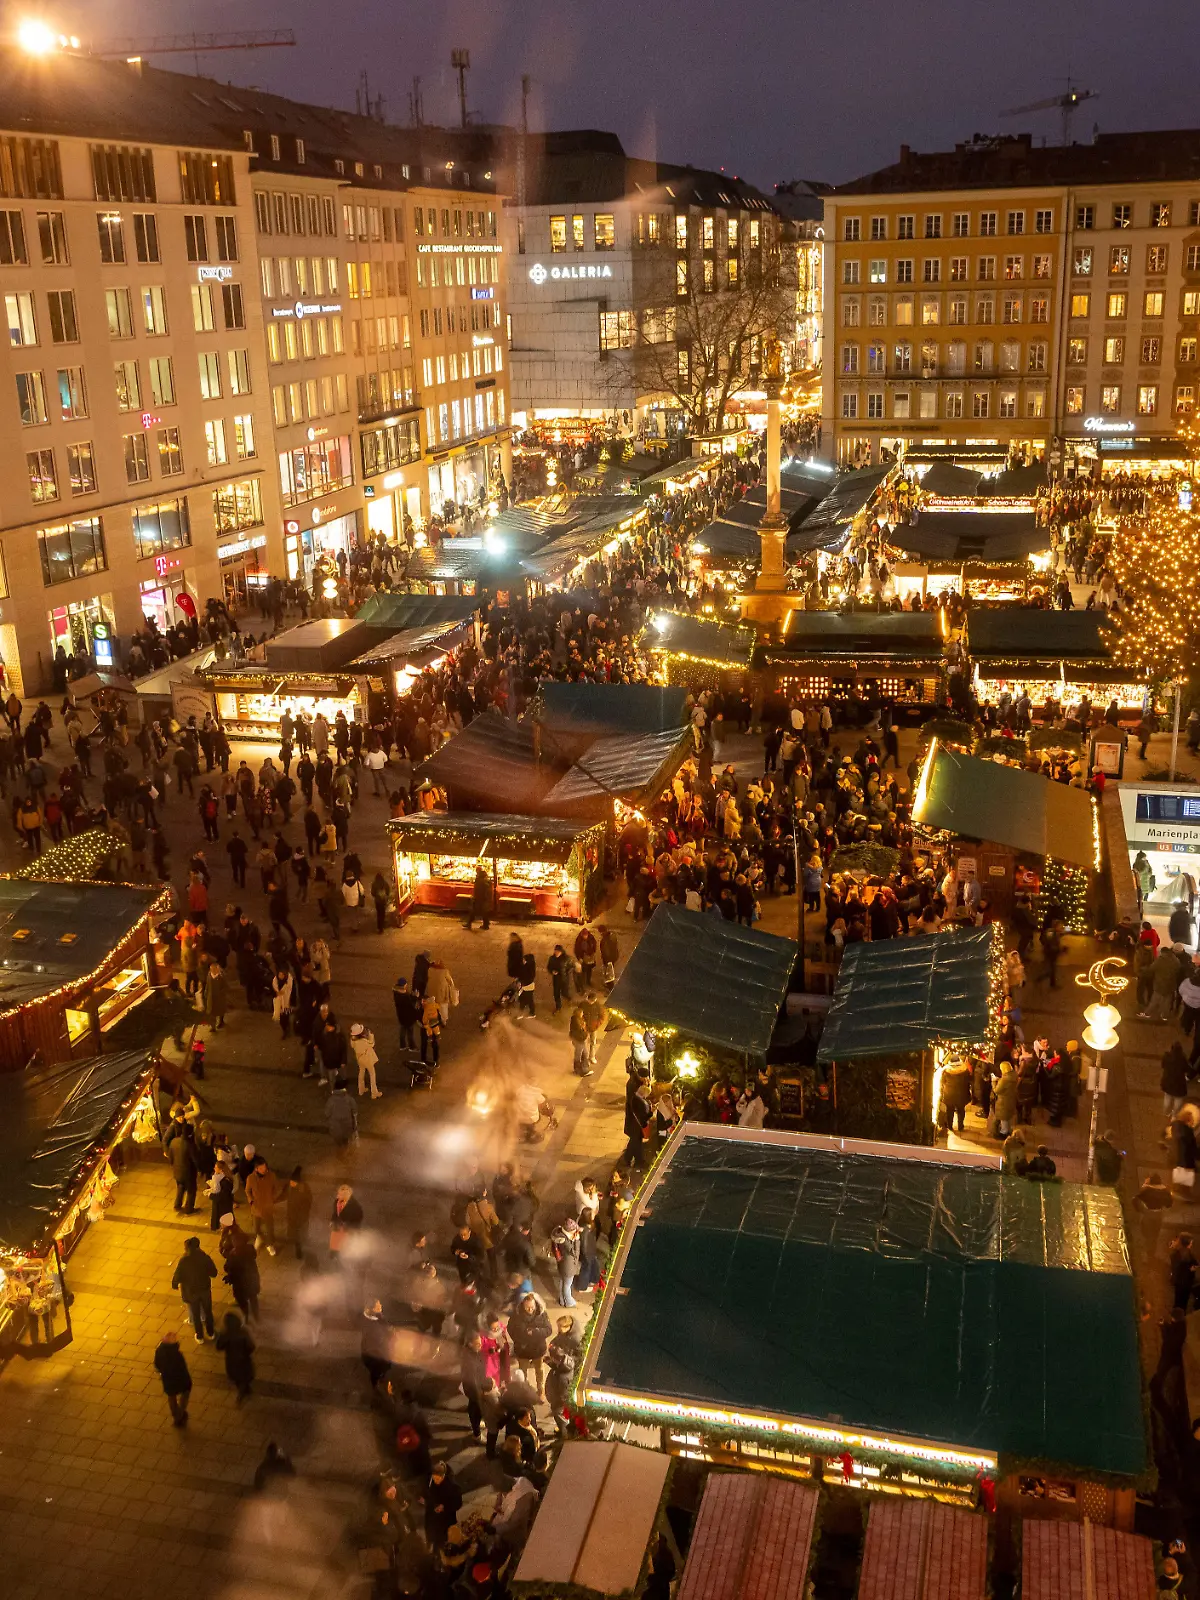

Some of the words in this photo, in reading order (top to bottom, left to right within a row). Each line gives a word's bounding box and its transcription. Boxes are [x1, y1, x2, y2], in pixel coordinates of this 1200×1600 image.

[551, 265, 612, 279] GALERIA
[95, 624, 107, 639] S
[97, 640, 108, 655] U
[1147, 828, 1200, 840] Marienpla
